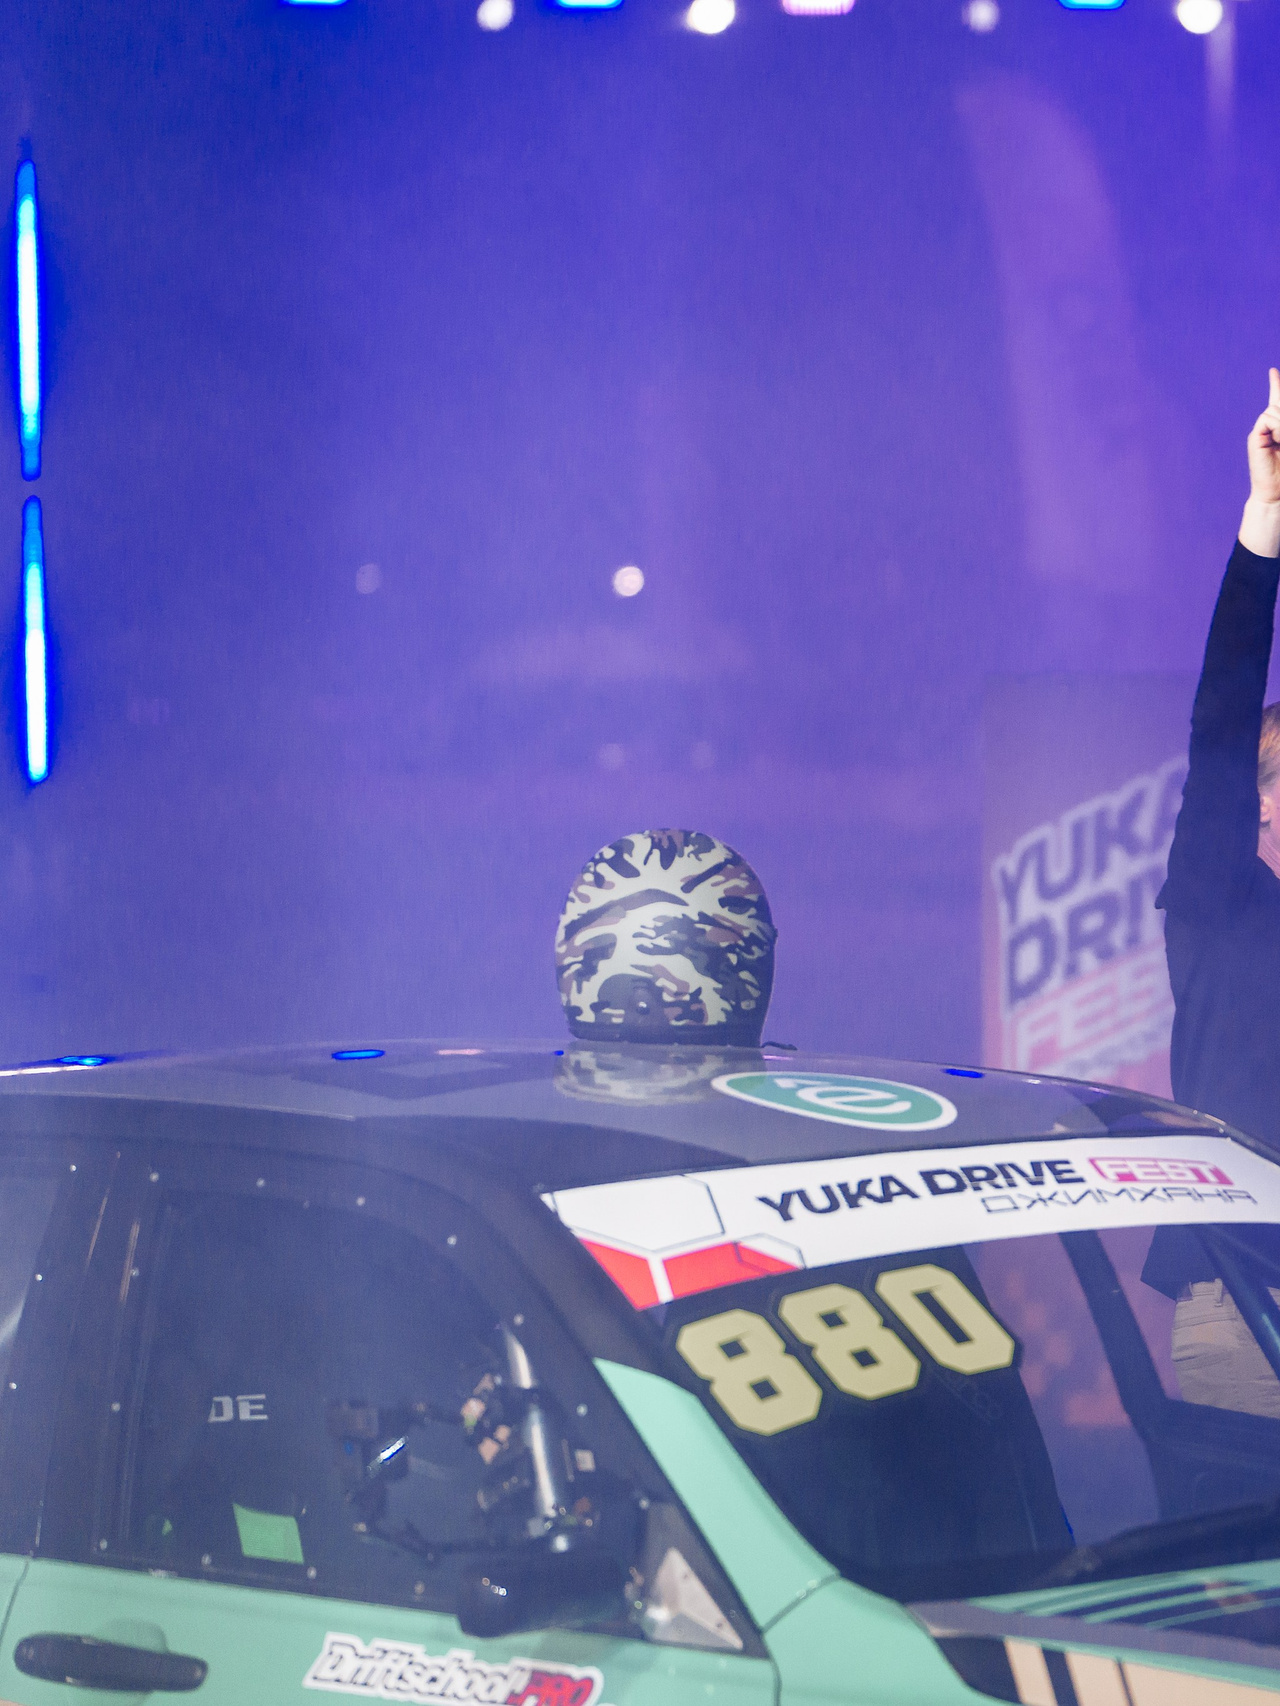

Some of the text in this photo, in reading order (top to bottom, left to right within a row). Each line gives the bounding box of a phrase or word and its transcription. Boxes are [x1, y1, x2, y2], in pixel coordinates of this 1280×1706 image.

[757, 1158, 1231, 1222] YUKA DRIVE FEST
[676, 1263, 1015, 1436] 880
